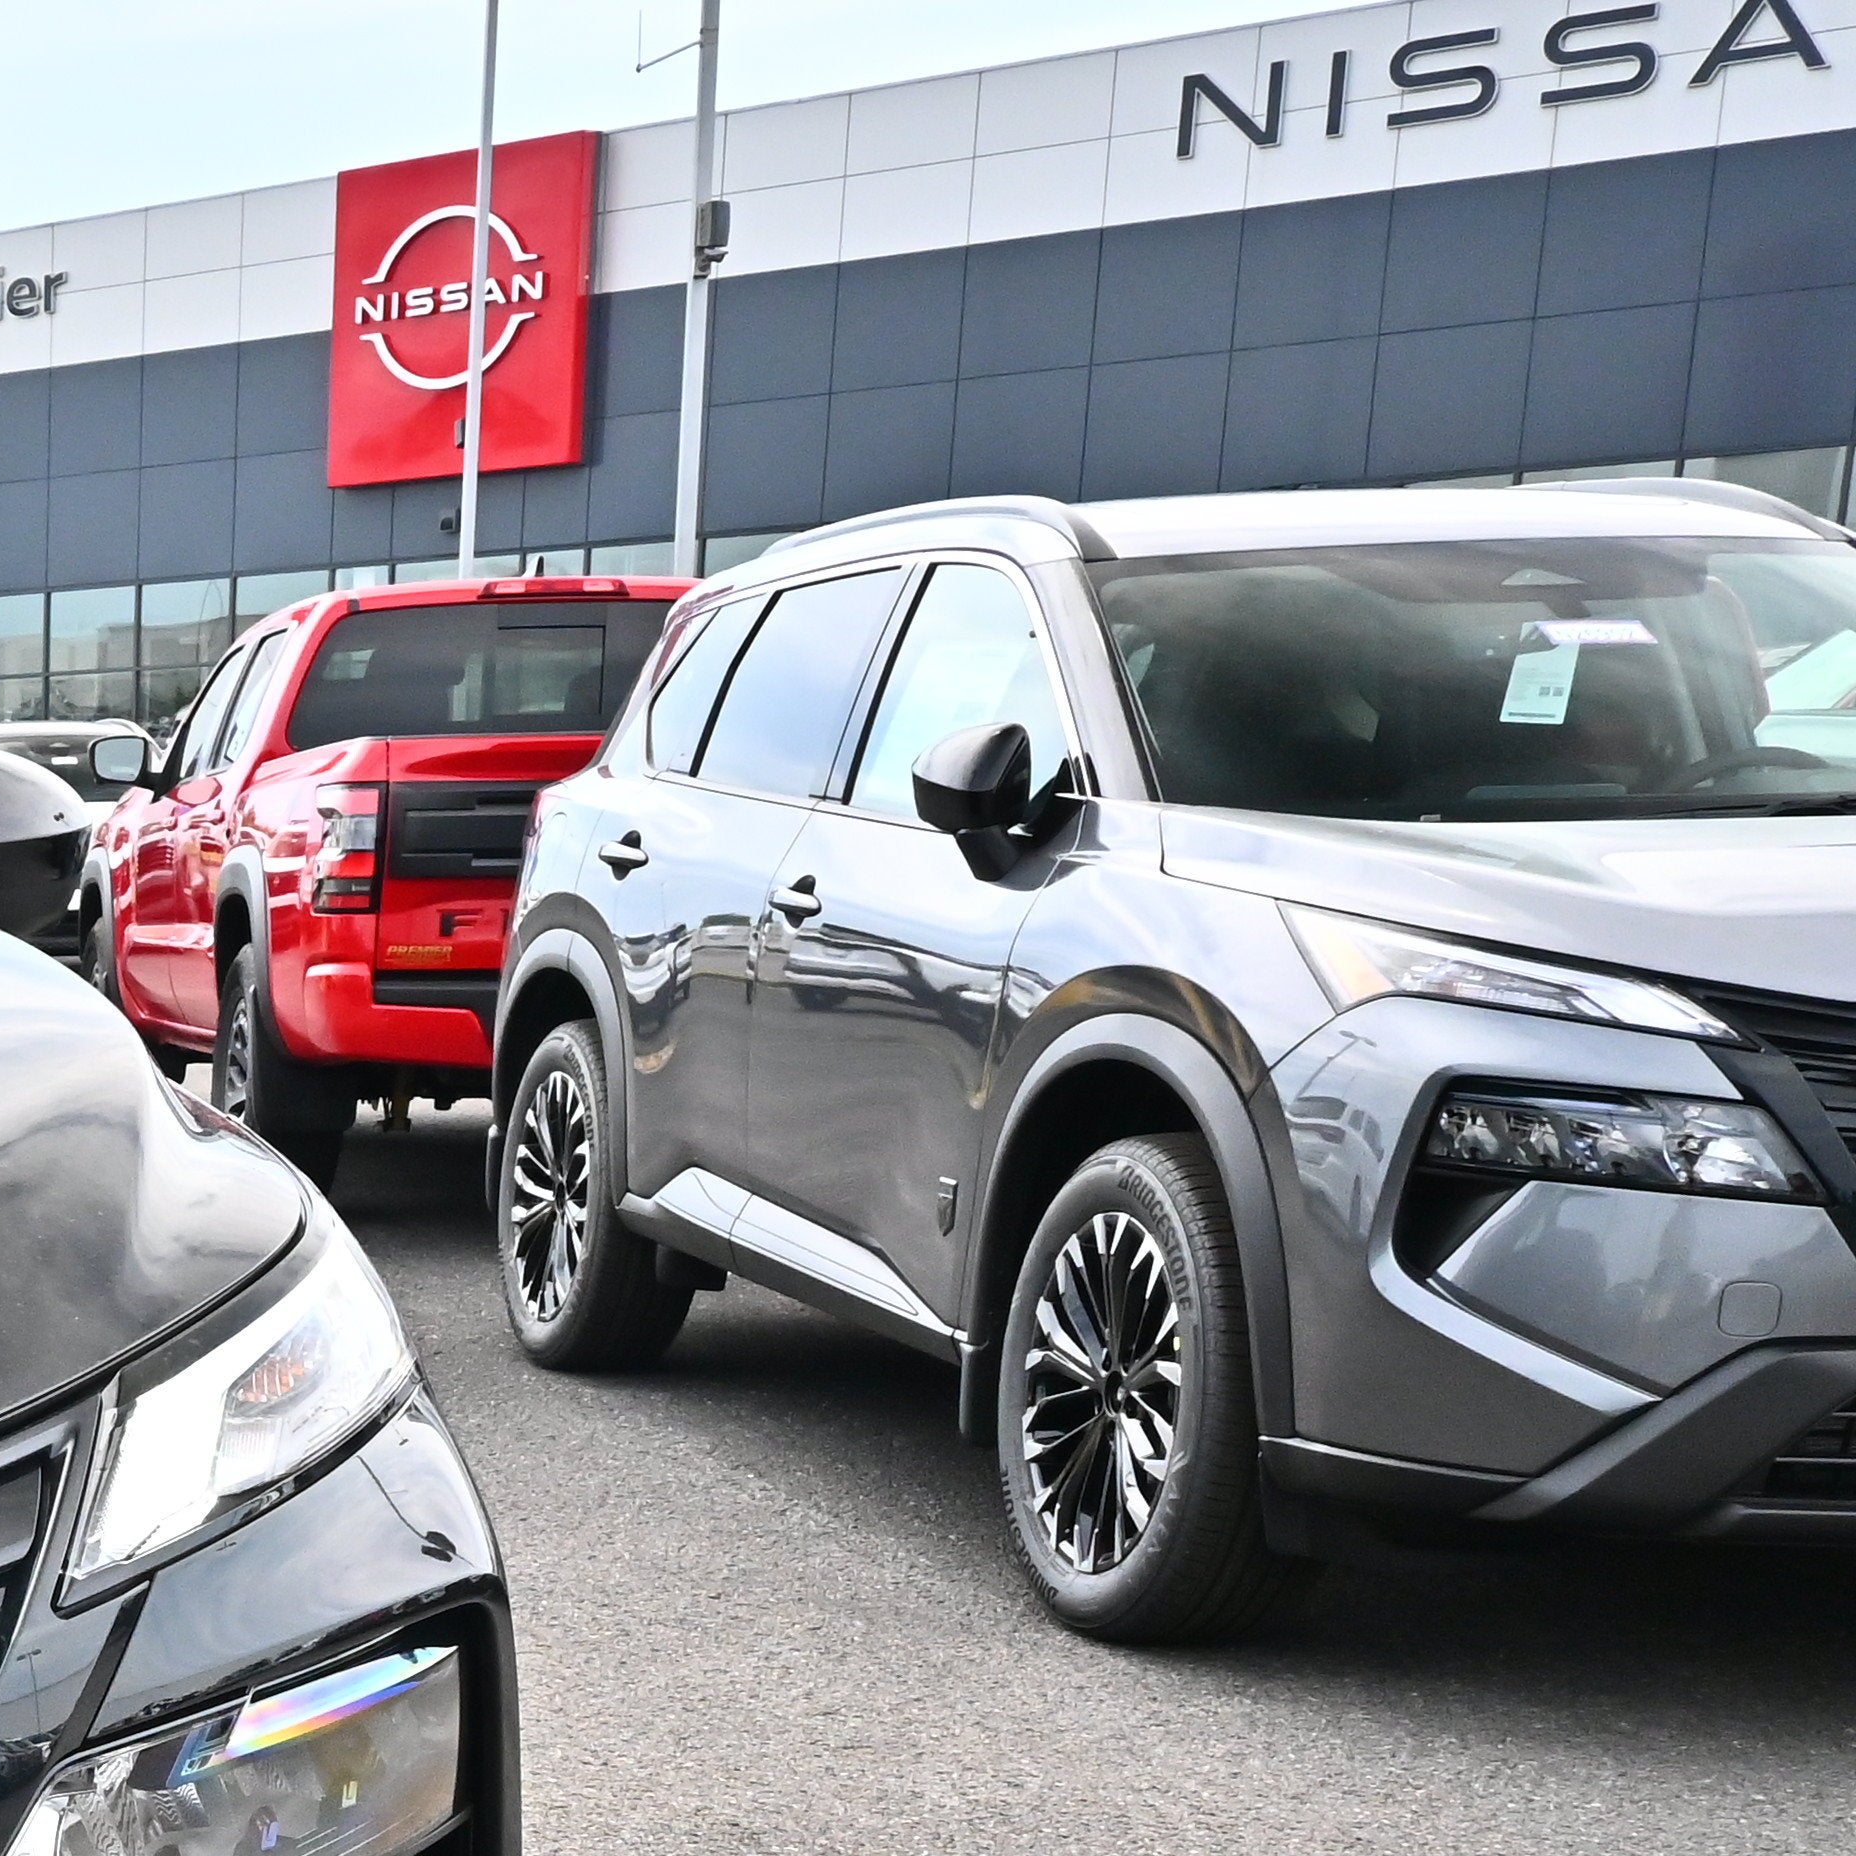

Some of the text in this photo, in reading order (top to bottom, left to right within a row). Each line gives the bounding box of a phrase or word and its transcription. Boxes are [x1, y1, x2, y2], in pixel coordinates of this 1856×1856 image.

[1176, 0, 1831, 160] NISSA
[354, 270, 544, 325] NISSAN
[1118, 1163, 1192, 1313] BRIDGESTONE
